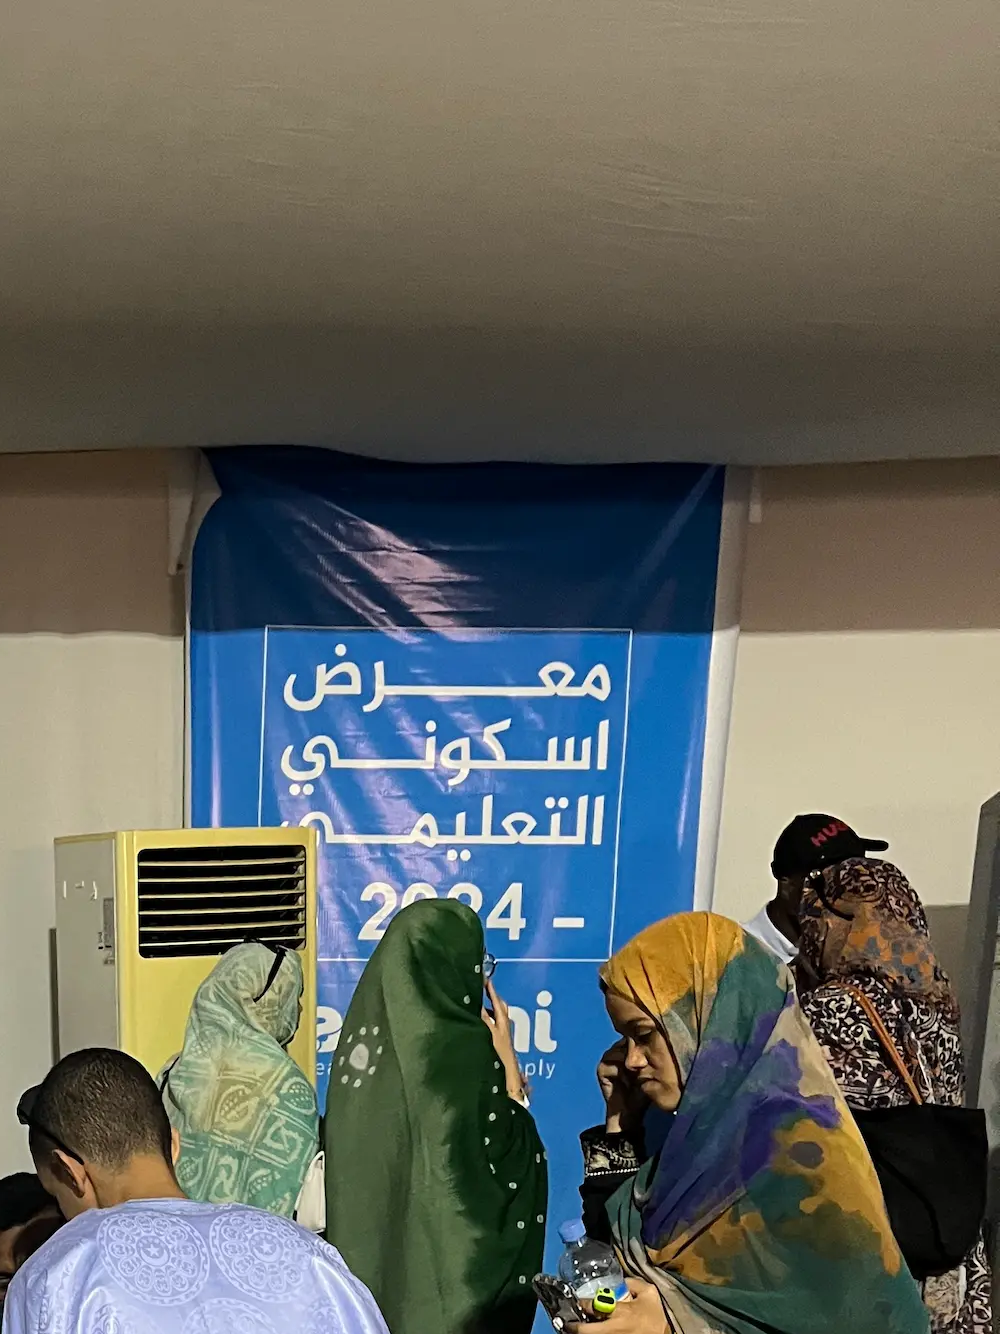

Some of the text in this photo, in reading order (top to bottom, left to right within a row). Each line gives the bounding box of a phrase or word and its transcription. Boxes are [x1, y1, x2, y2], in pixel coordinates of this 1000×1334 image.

[283, 643, 612, 713] معرض
[280, 717, 611, 796] اسكوني
[358, 882, 526, 941] 24
